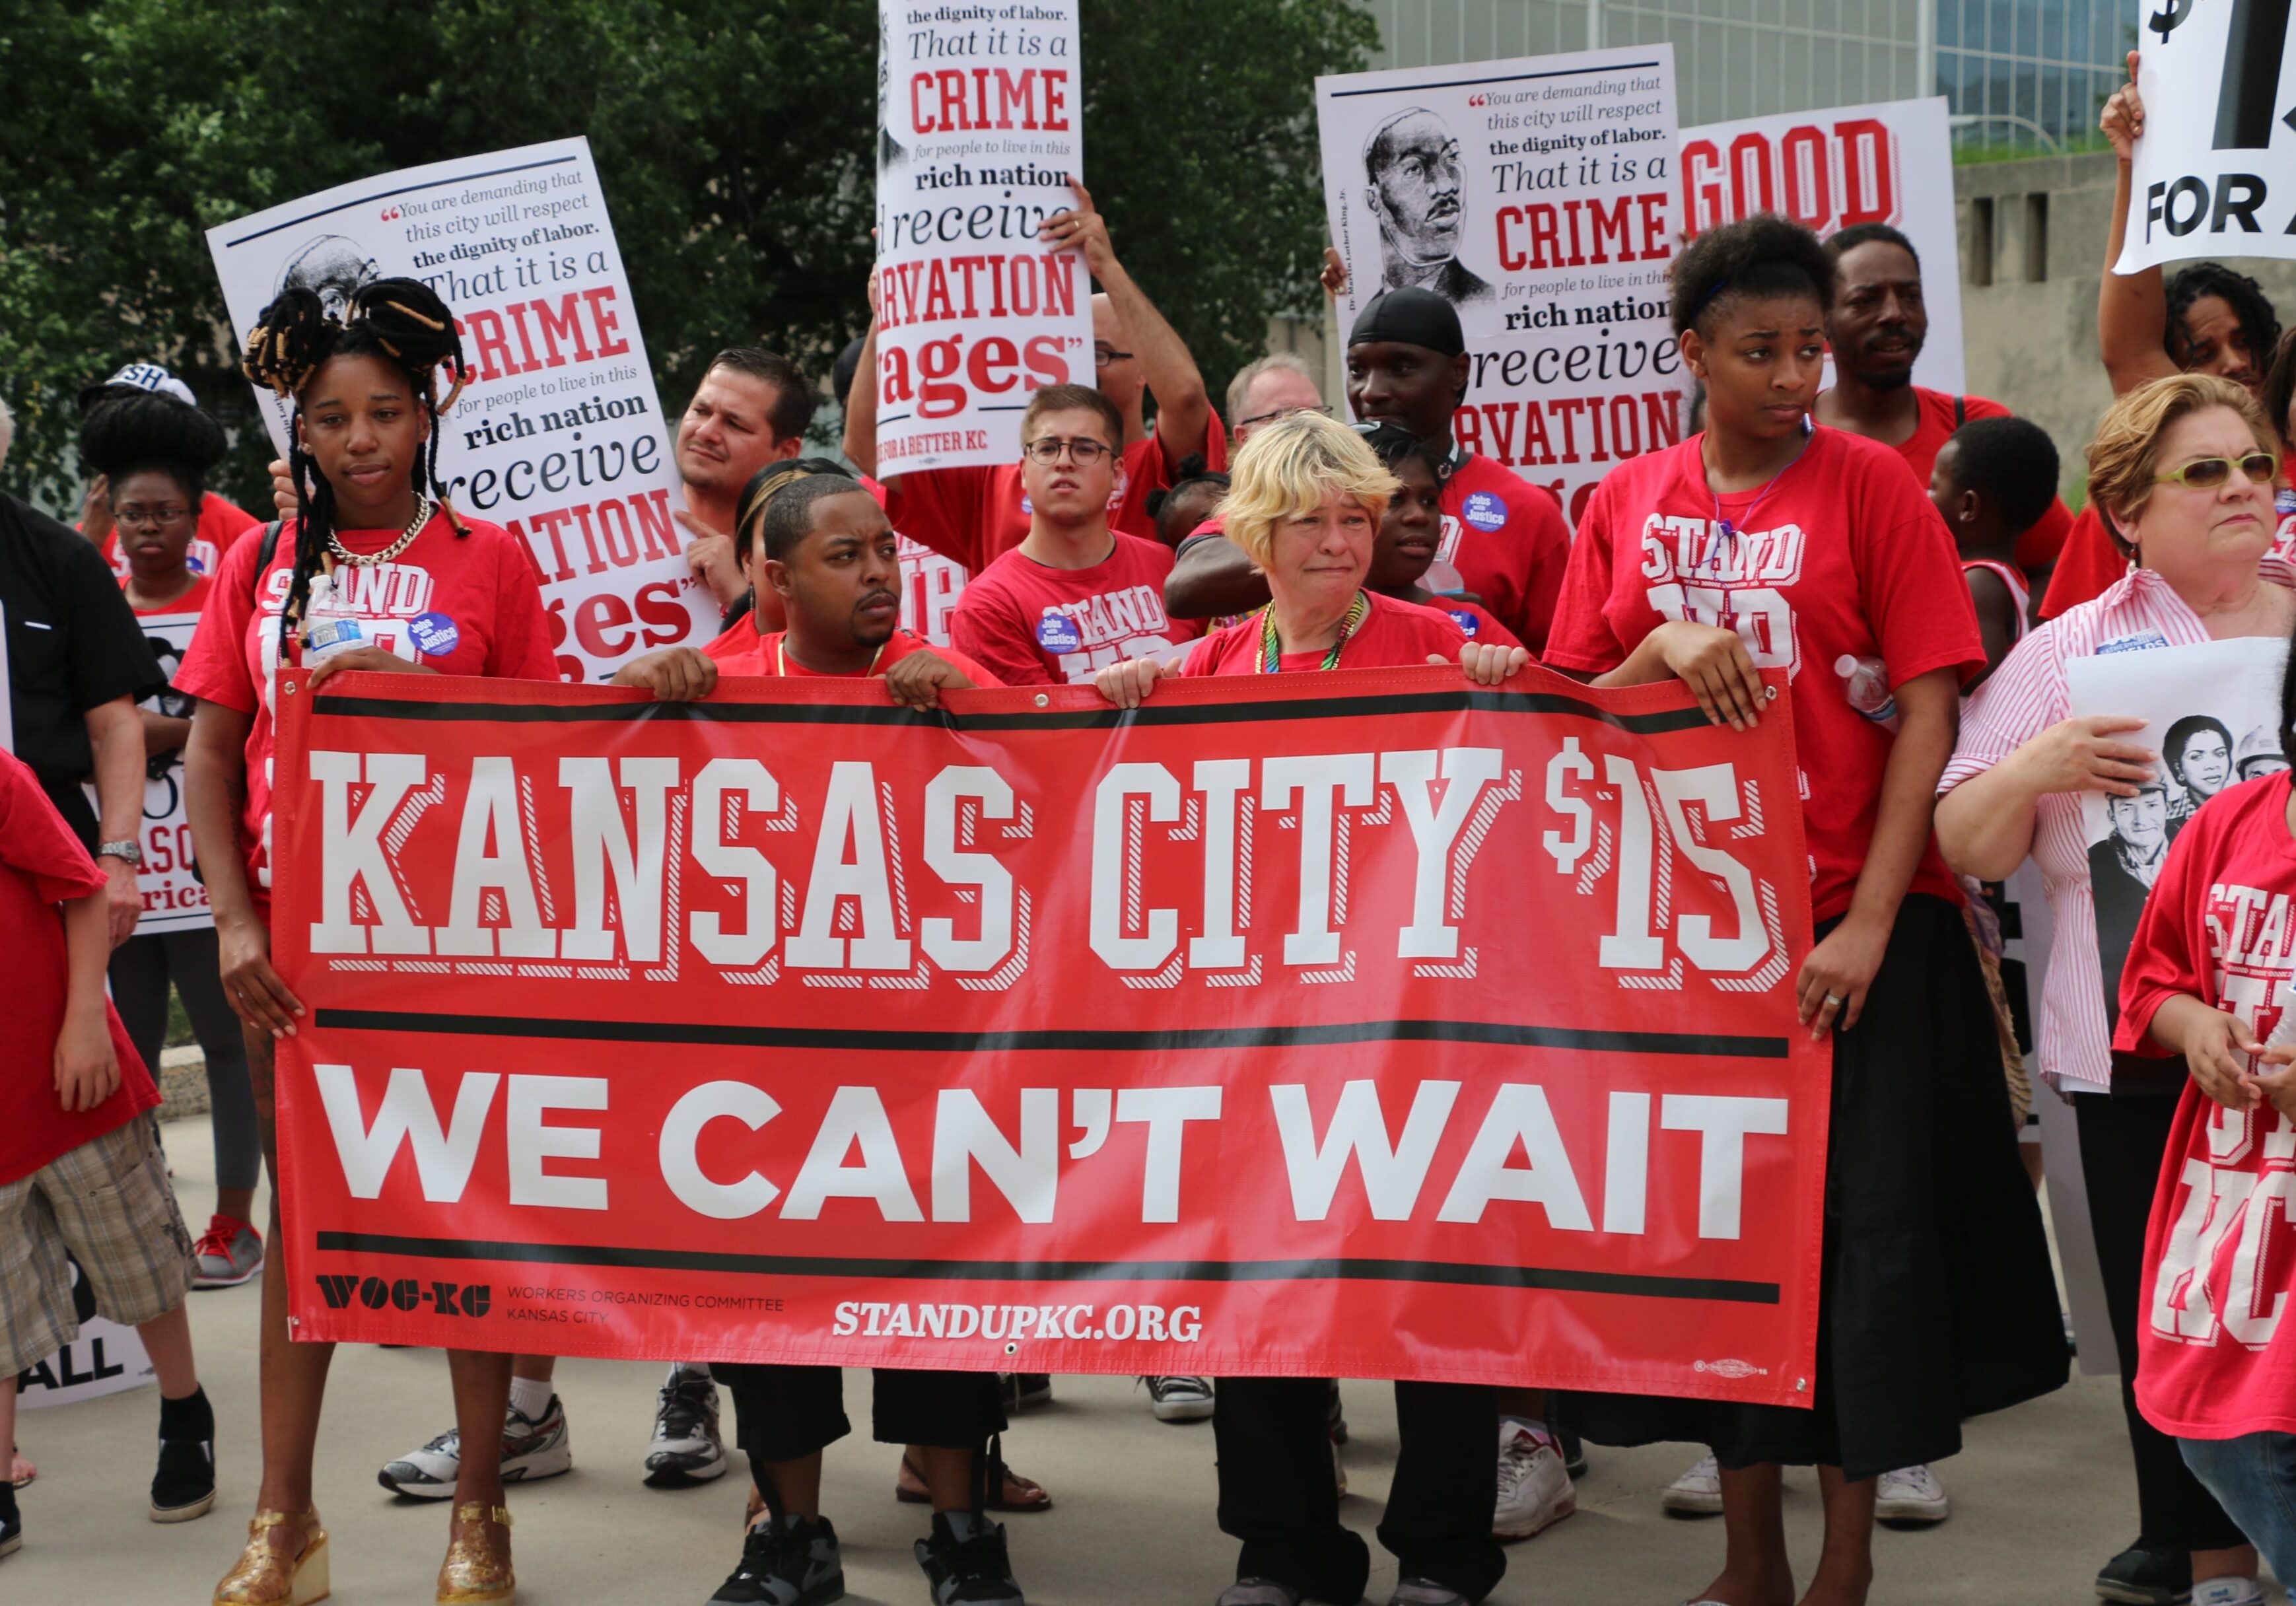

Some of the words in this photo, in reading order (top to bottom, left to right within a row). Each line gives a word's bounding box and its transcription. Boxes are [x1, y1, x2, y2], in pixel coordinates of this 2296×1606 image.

[907, 10, 931, 24] the
[935, 5, 996, 22] dignity
[1000, 5, 1018, 18] of
[1020, 5, 1068, 21] labor.
[908, 29, 977, 60] That
[988, 28, 1008, 55] it
[1018, 28, 1041, 55] is
[1050, 35, 1067, 57] a
[911, 68, 1068, 134] CRIME
[1515, 90, 1539, 103] are
[1543, 80, 1626, 100] demanding
[1630, 76, 1660, 91] that
[1488, 113, 1519, 130] this
[1523, 110, 1555, 128] city
[1560, 104, 1593, 123] will
[1598, 100, 1661, 120] respect
[913, 144, 933, 161] for
[936, 141, 981, 158] people
[985, 141, 998, 153] to
[1002, 139, 1027, 153] live
[1030, 141, 1043, 154] in
[1046, 140, 1070, 155] this
[1490, 141, 1518, 155] the
[1523, 135, 1587, 153] dignity
[1591, 131, 1609, 146] of
[1613, 127, 1666, 144] labor.
[431, 197, 457, 211] are
[460, 179, 547, 205] demanding
[551, 170, 583, 188] that
[915, 164, 973, 190] rich
[979, 163, 1072, 187] nation
[1492, 160, 1568, 193] That
[1579, 156, 1601, 186] it
[1611, 153, 1637, 183] is
[1647, 156, 1667, 179] a
[1681, 118, 1898, 239] GOOD
[405, 222, 441, 242] this
[445, 215, 479, 234] city
[483, 204, 519, 226] will
[523, 193, 589, 219] respect
[2145, 174, 2267, 245] FOR
[413, 248, 446, 268] the
[449, 234, 517, 260] dignity
[522, 227, 542, 246] of
[543, 221, 600, 243] labor.
[1496, 192, 1671, 271] CRIME
[421, 264, 508, 302] That
[515, 257, 541, 287] it
[549, 251, 576, 281] is
[586, 250, 609, 273] a
[1502, 283, 1526, 299] for
[1529, 278, 1576, 297] people
[1581, 277, 1594, 291] to
[1598, 275, 1624, 289] live
[1628, 272, 1642, 287] in
[1506, 302, 1568, 330] rich
[1473, 328, 1681, 388] receive
[456, 400, 481, 419] for
[485, 384, 537, 411] people
[541, 381, 556, 396] to
[559, 375, 586, 392] live
[590, 370, 606, 386] in
[608, 365, 637, 383] this
[464, 411, 536, 450] rich
[540, 395, 648, 431] nation
[908, 431, 962, 456] BETTER
[966, 430, 988, 450] KC
[440, 431, 660, 510] receive
[1467, 509, 1505, 524] Justice
[1469, 495, 1491, 505] Jobs
[1641, 512, 1806, 586] STAND
[411, 619, 433, 633] Jobs
[420, 627, 458, 650] Justice
[1041, 634, 1077, 645] Justice
[1042, 619, 1062, 629] Jobs
[309, 750, 1032, 991] KANSAS
[1090, 748, 1521, 989] CITY
[1543, 737, 1790, 993] $15
[314, 1065, 608, 1210] WE
[659, 1080, 1222, 1223] CAN'T
[1270, 1080, 1788, 1239] WAIT
[507, 1286, 586, 1302] WORKERS
[591, 1291, 690, 1308] ORGANIZING
[694, 1295, 784, 1311] COMMITTEE
[507, 1308, 568, 1323] KANSAS
[573, 1311, 609, 1324] CITY
[832, 1302, 1202, 1342] STANDUPKC.ORG
[17, 1337, 124, 1395] ALL
